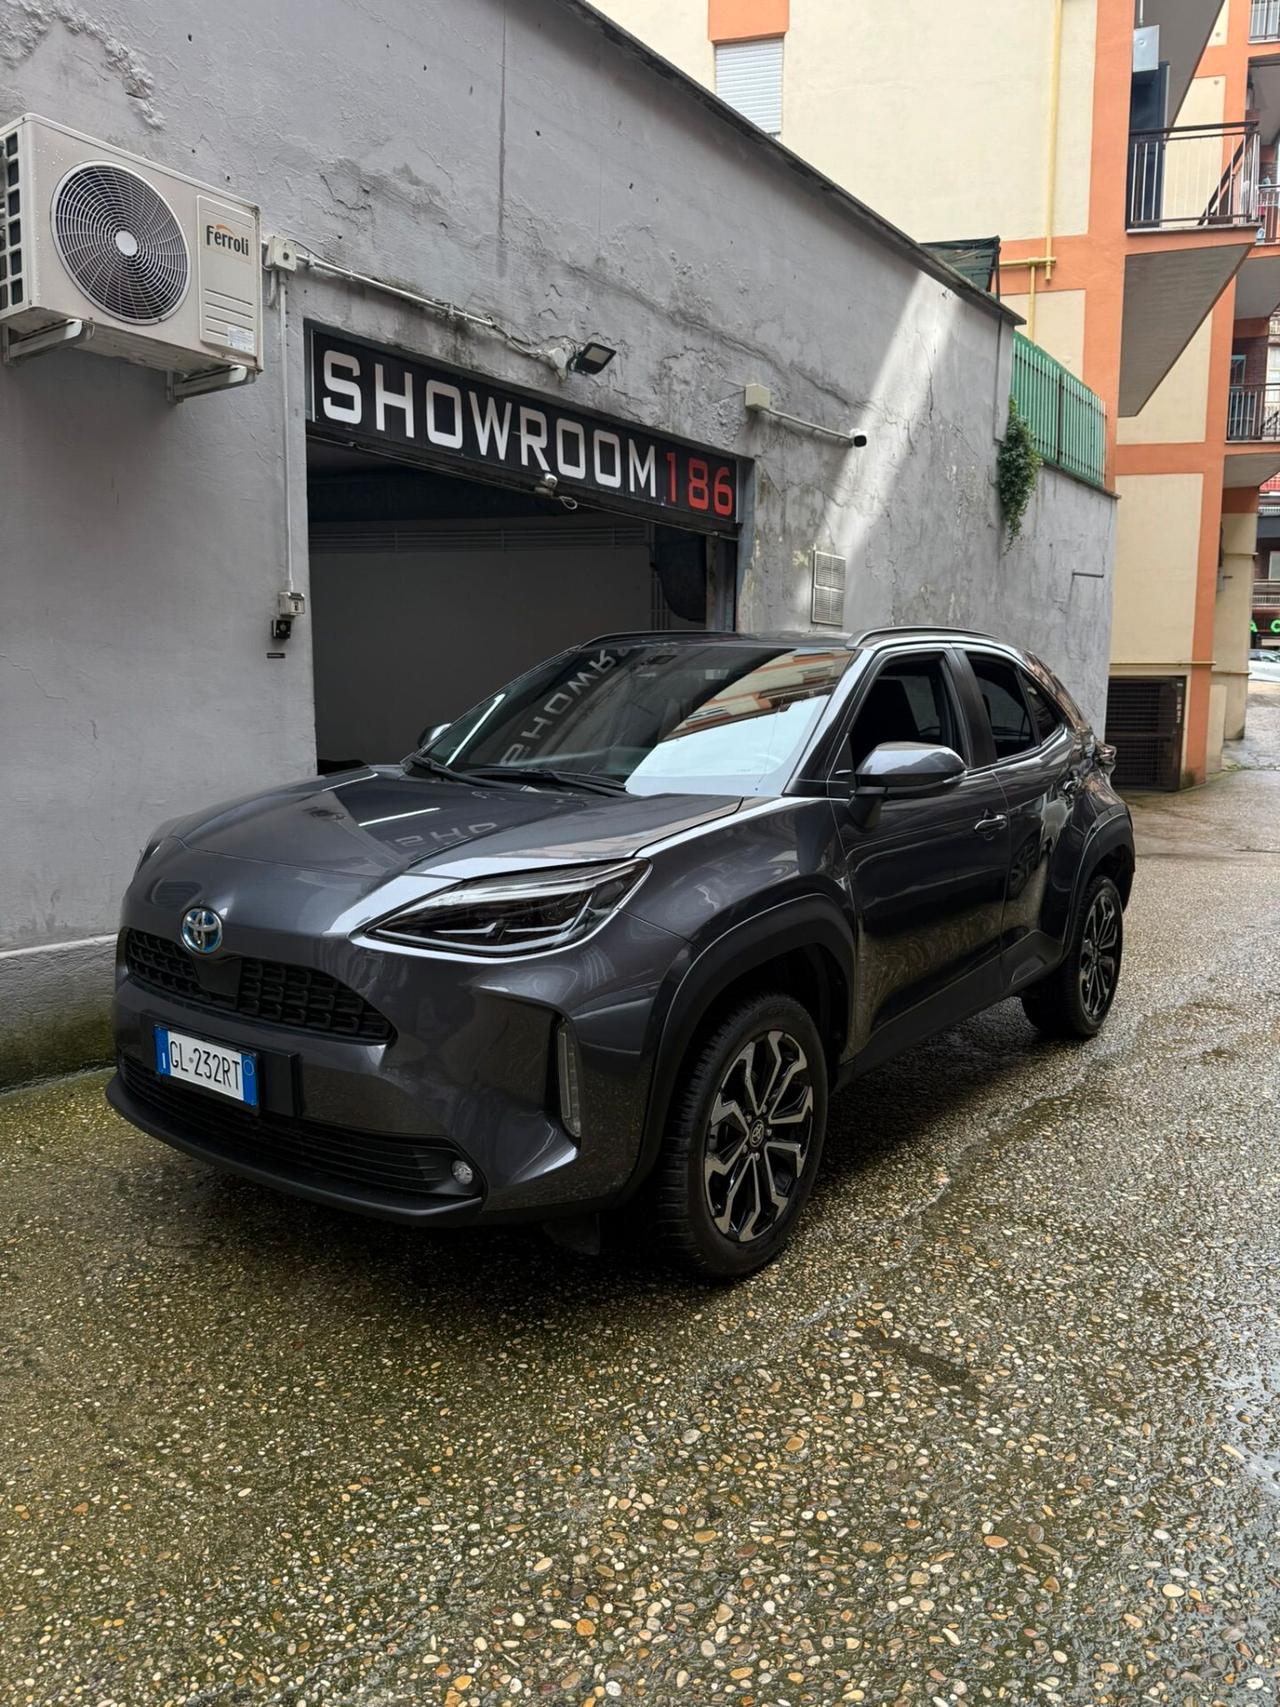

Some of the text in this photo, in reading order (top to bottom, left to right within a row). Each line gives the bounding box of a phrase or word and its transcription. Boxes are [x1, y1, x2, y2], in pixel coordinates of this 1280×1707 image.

[206, 224, 250, 256] Ferroli
[322, 349, 734, 517] SHOWROOM 186
